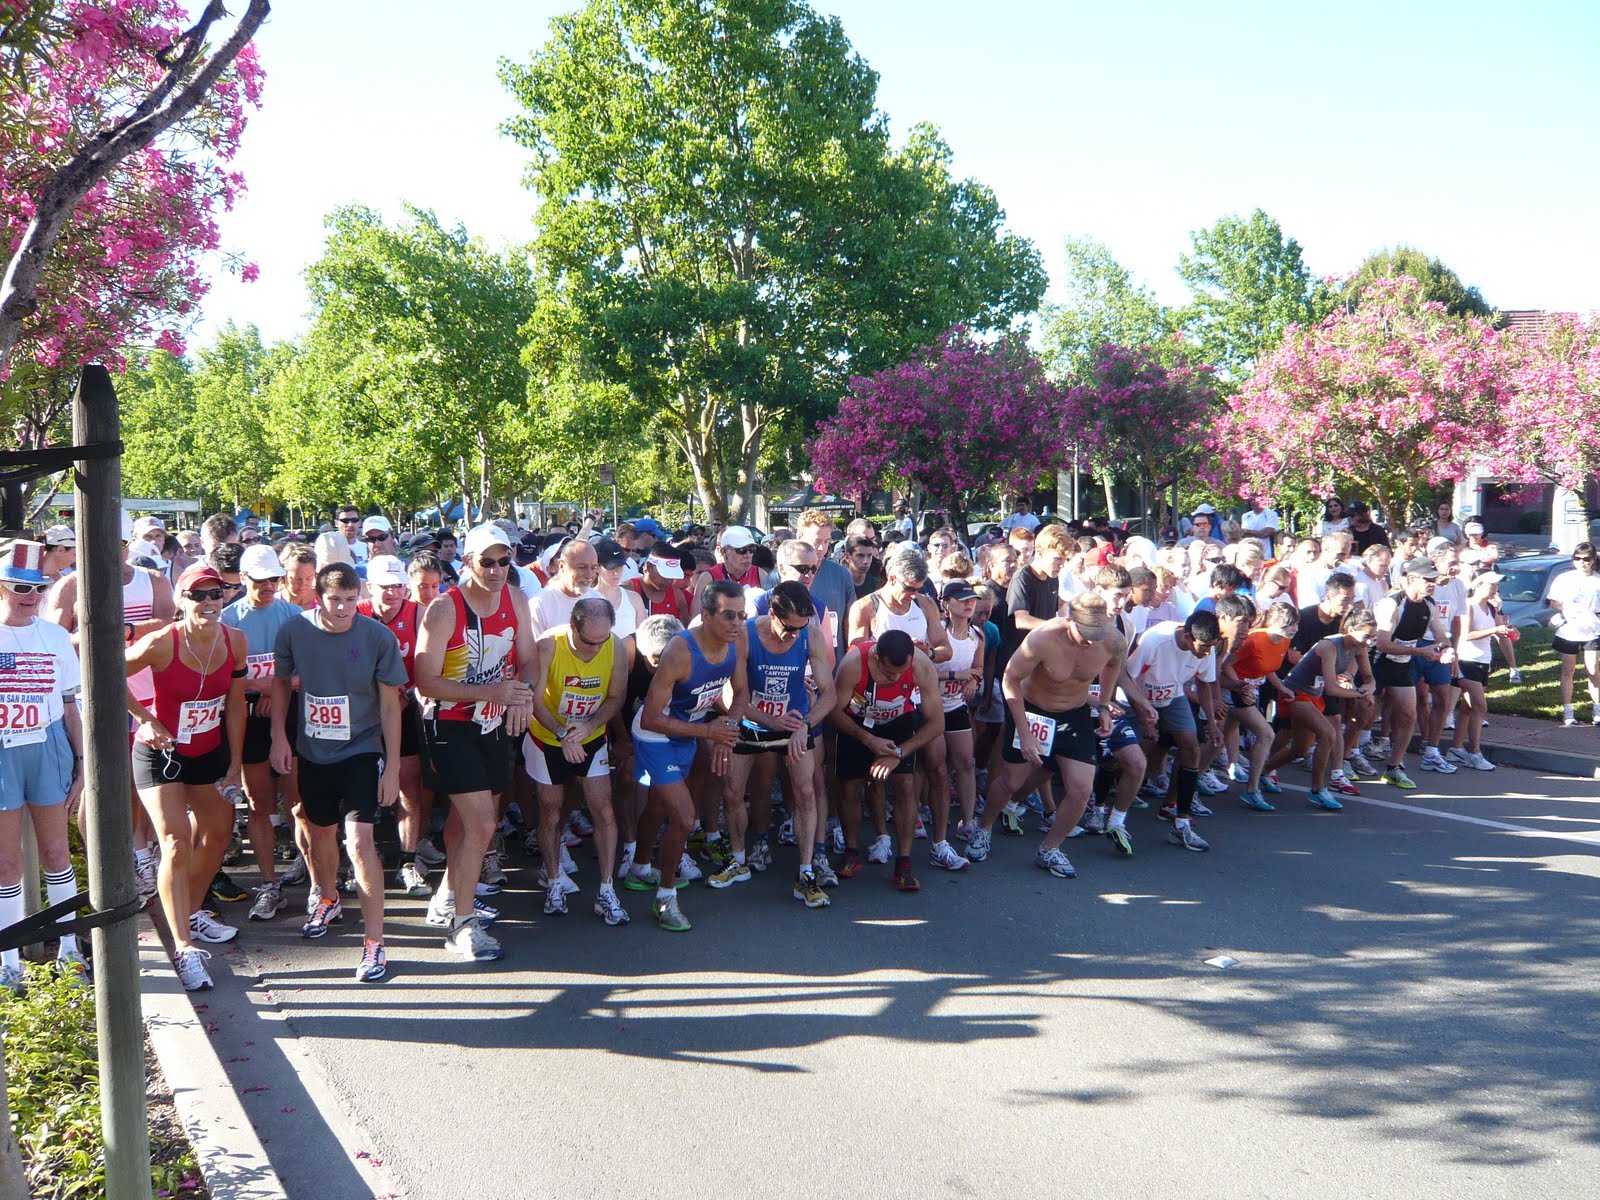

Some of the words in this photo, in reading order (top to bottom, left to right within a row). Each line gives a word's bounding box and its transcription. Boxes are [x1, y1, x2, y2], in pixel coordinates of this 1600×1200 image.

[7, 695, 20, 704] SAN
[21, 695, 44, 704] RAMON
[326, 697, 346, 705] RAMON
[1147, 689, 1172, 701] 122
[310, 704, 341, 725] 289
[565, 700, 596, 716] 157
[757, 700, 784, 718] 403
[187, 706, 218, 728] 524
[1028, 721, 1049, 742] 86
